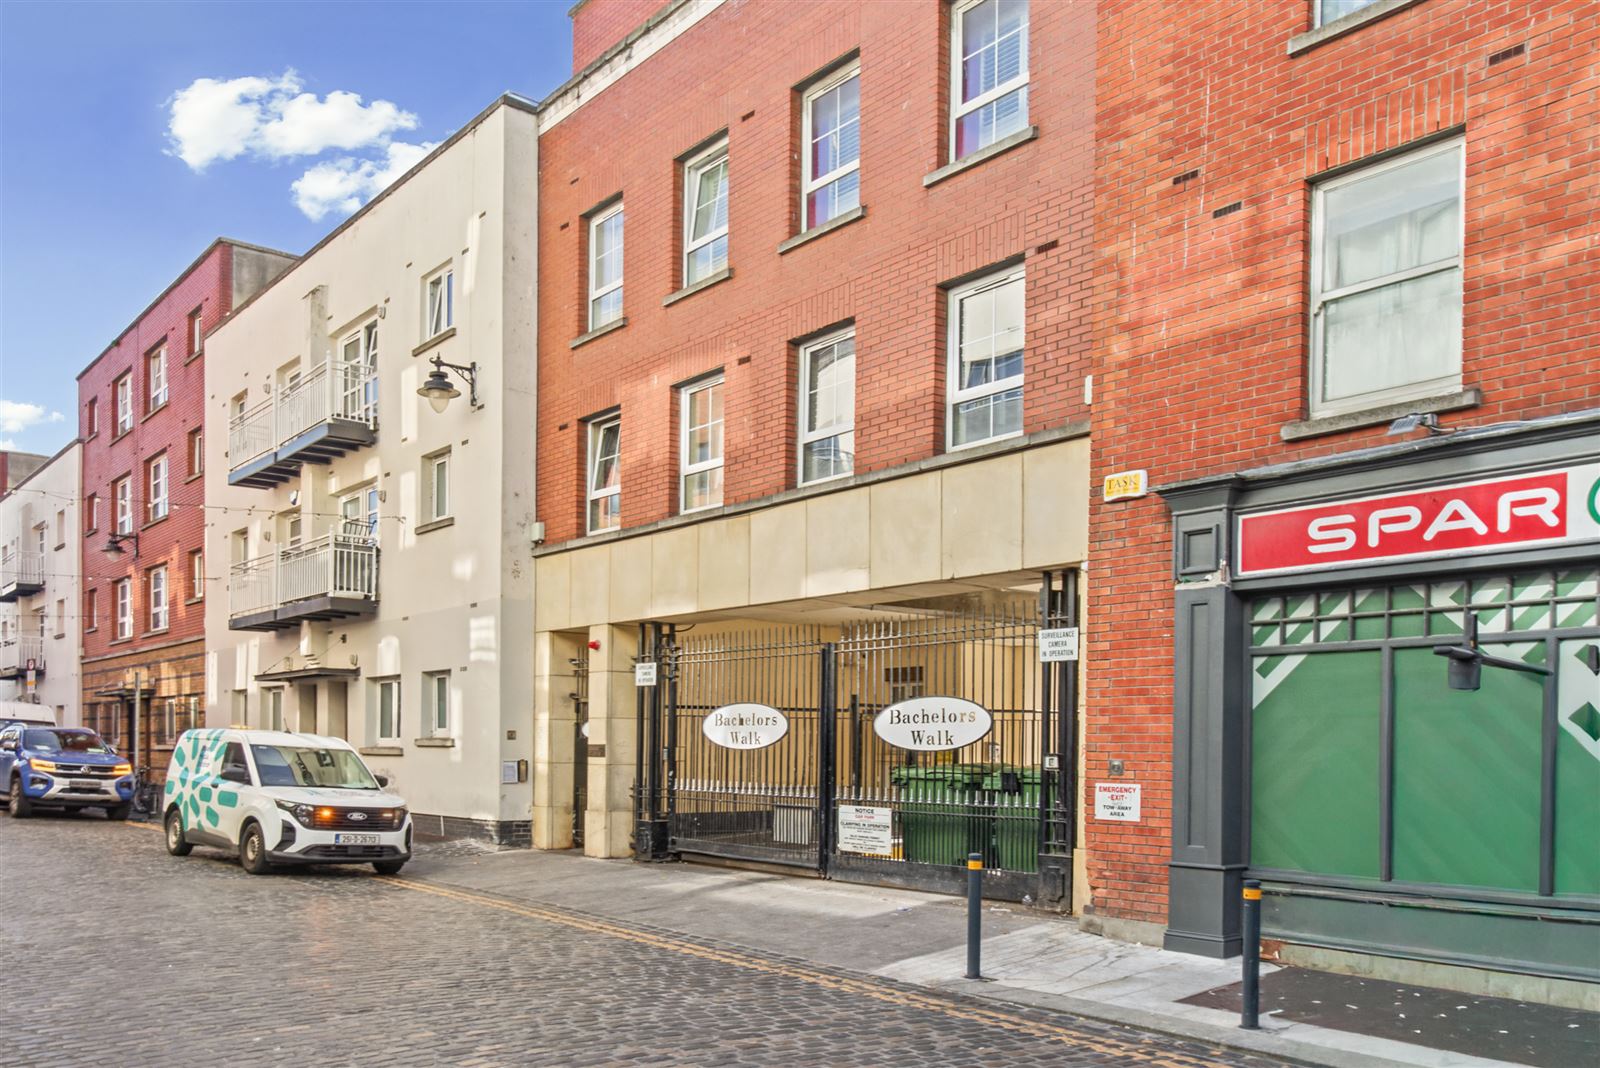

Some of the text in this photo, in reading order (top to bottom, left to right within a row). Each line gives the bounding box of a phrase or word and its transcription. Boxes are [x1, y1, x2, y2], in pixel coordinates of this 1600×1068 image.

[1106, 475, 1137, 490] TASK
[1307, 487, 1560, 554] SPAR
[1041, 630, 1075, 639] SURVEILLANCE
[1048, 640, 1067, 648] CAMERA
[1048, 649, 1074, 657] OPERATION
[715, 712, 778, 726] Bachelors
[889, 707, 976, 725] Bachelors
[730, 731, 761, 745] Walk
[910, 729, 955, 746] Walk
[1098, 785, 1137, 794] EMERGENCY
